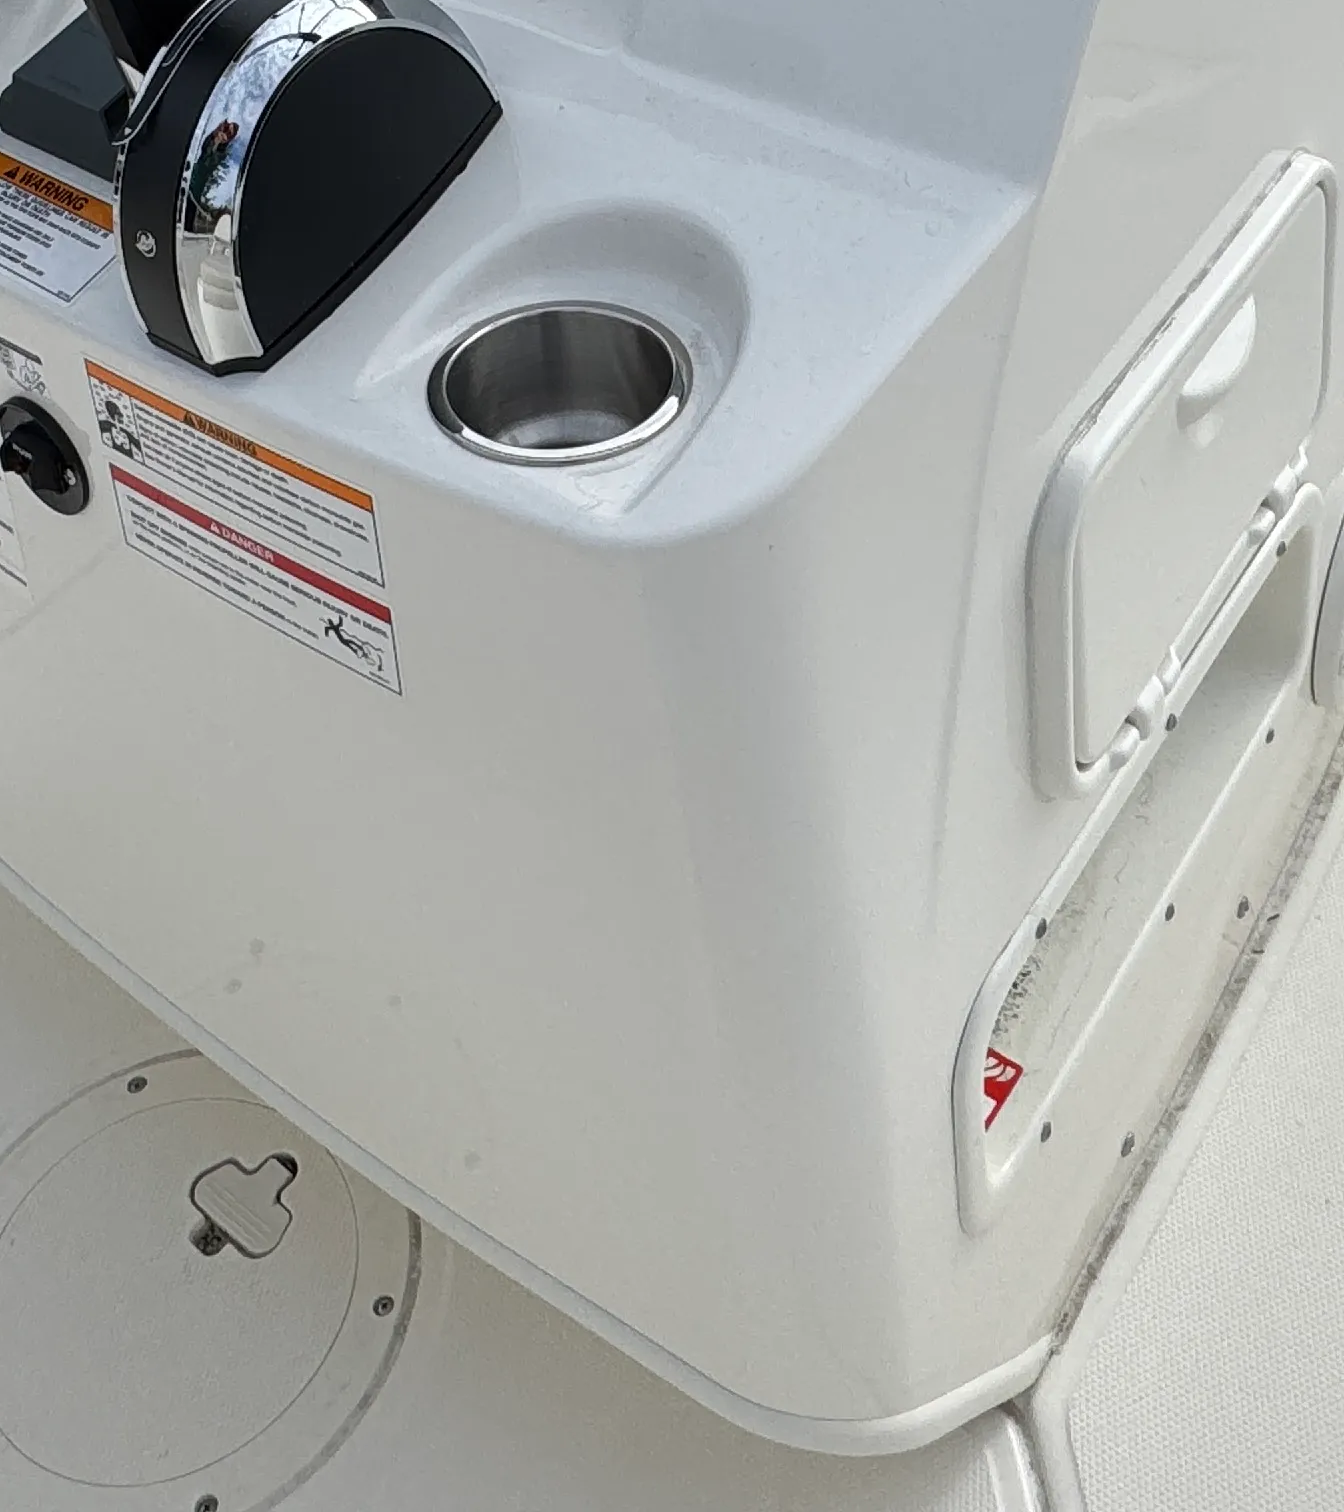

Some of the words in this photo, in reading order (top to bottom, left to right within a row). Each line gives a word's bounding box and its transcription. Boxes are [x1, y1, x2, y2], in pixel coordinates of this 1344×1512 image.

[18, 169, 90, 213] WARNING
[194, 413, 258, 457] WARNING
[220, 526, 276, 564] DANGER
